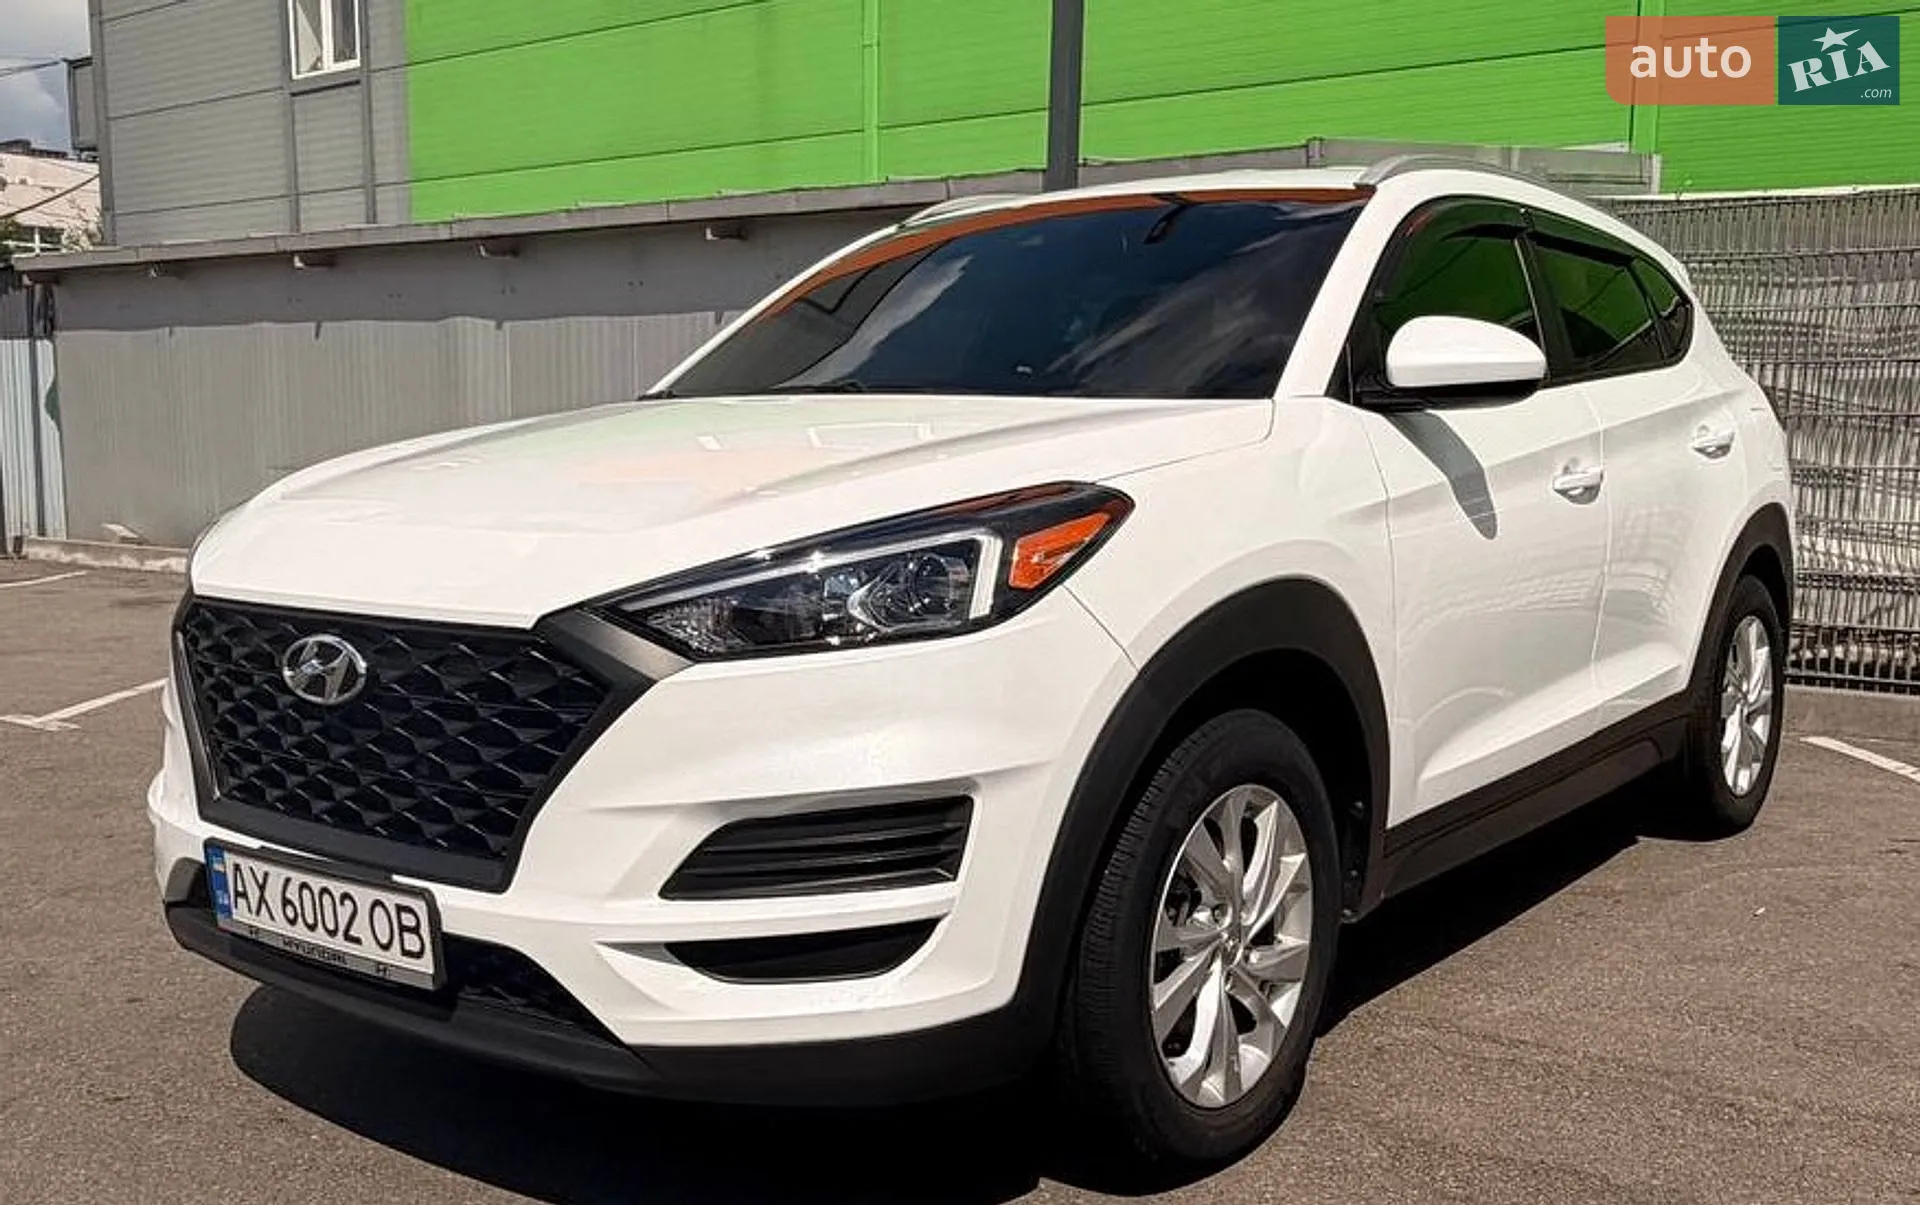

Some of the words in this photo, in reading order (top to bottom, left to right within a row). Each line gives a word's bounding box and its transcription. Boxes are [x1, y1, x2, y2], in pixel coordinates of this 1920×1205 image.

[233, 863, 275, 922] AX
[281, 877, 362, 945] 6002
[369, 899, 425, 959] OB
